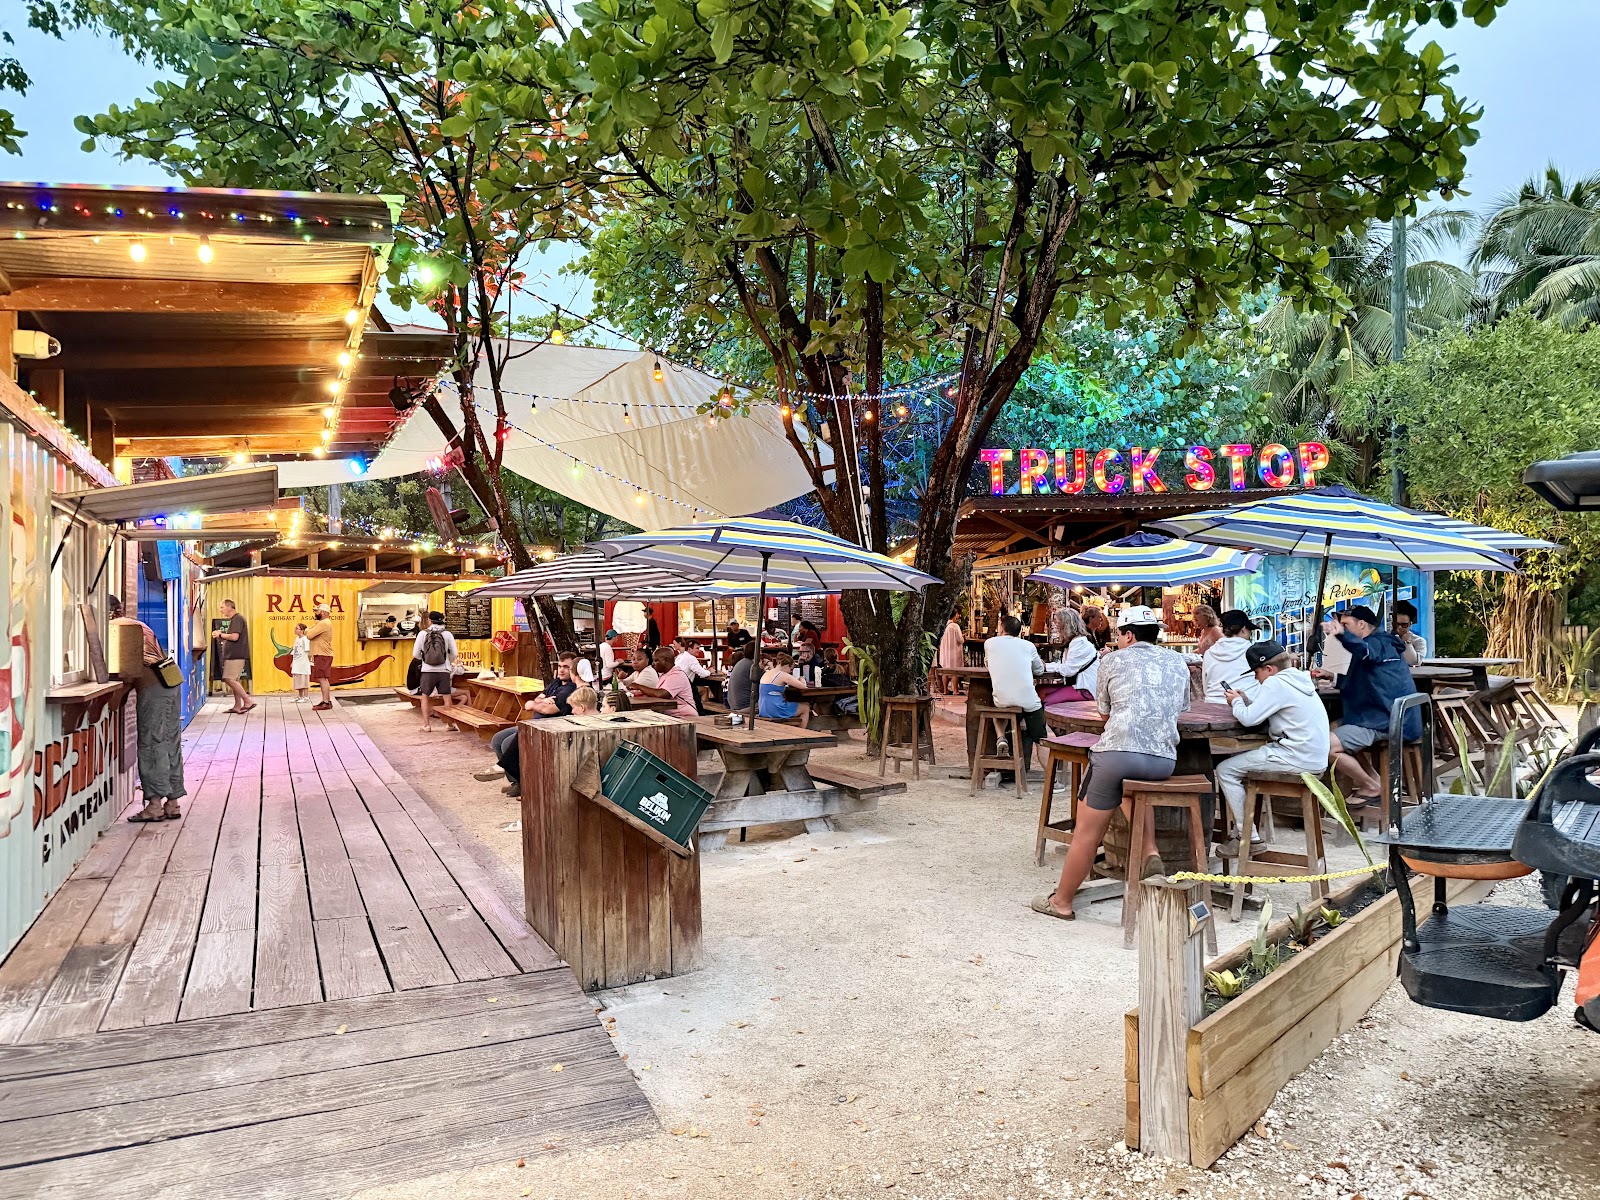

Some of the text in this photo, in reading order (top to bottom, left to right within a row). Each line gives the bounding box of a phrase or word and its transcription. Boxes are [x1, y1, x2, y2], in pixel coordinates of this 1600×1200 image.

[980, 442, 1330, 495] TRUCK STOP
[266, 594, 345, 613] RASA
[1282, 596, 1303, 613] from
[1329, 584, 1357, 601] Pedro
[638, 796, 672, 822] BELIKIN
